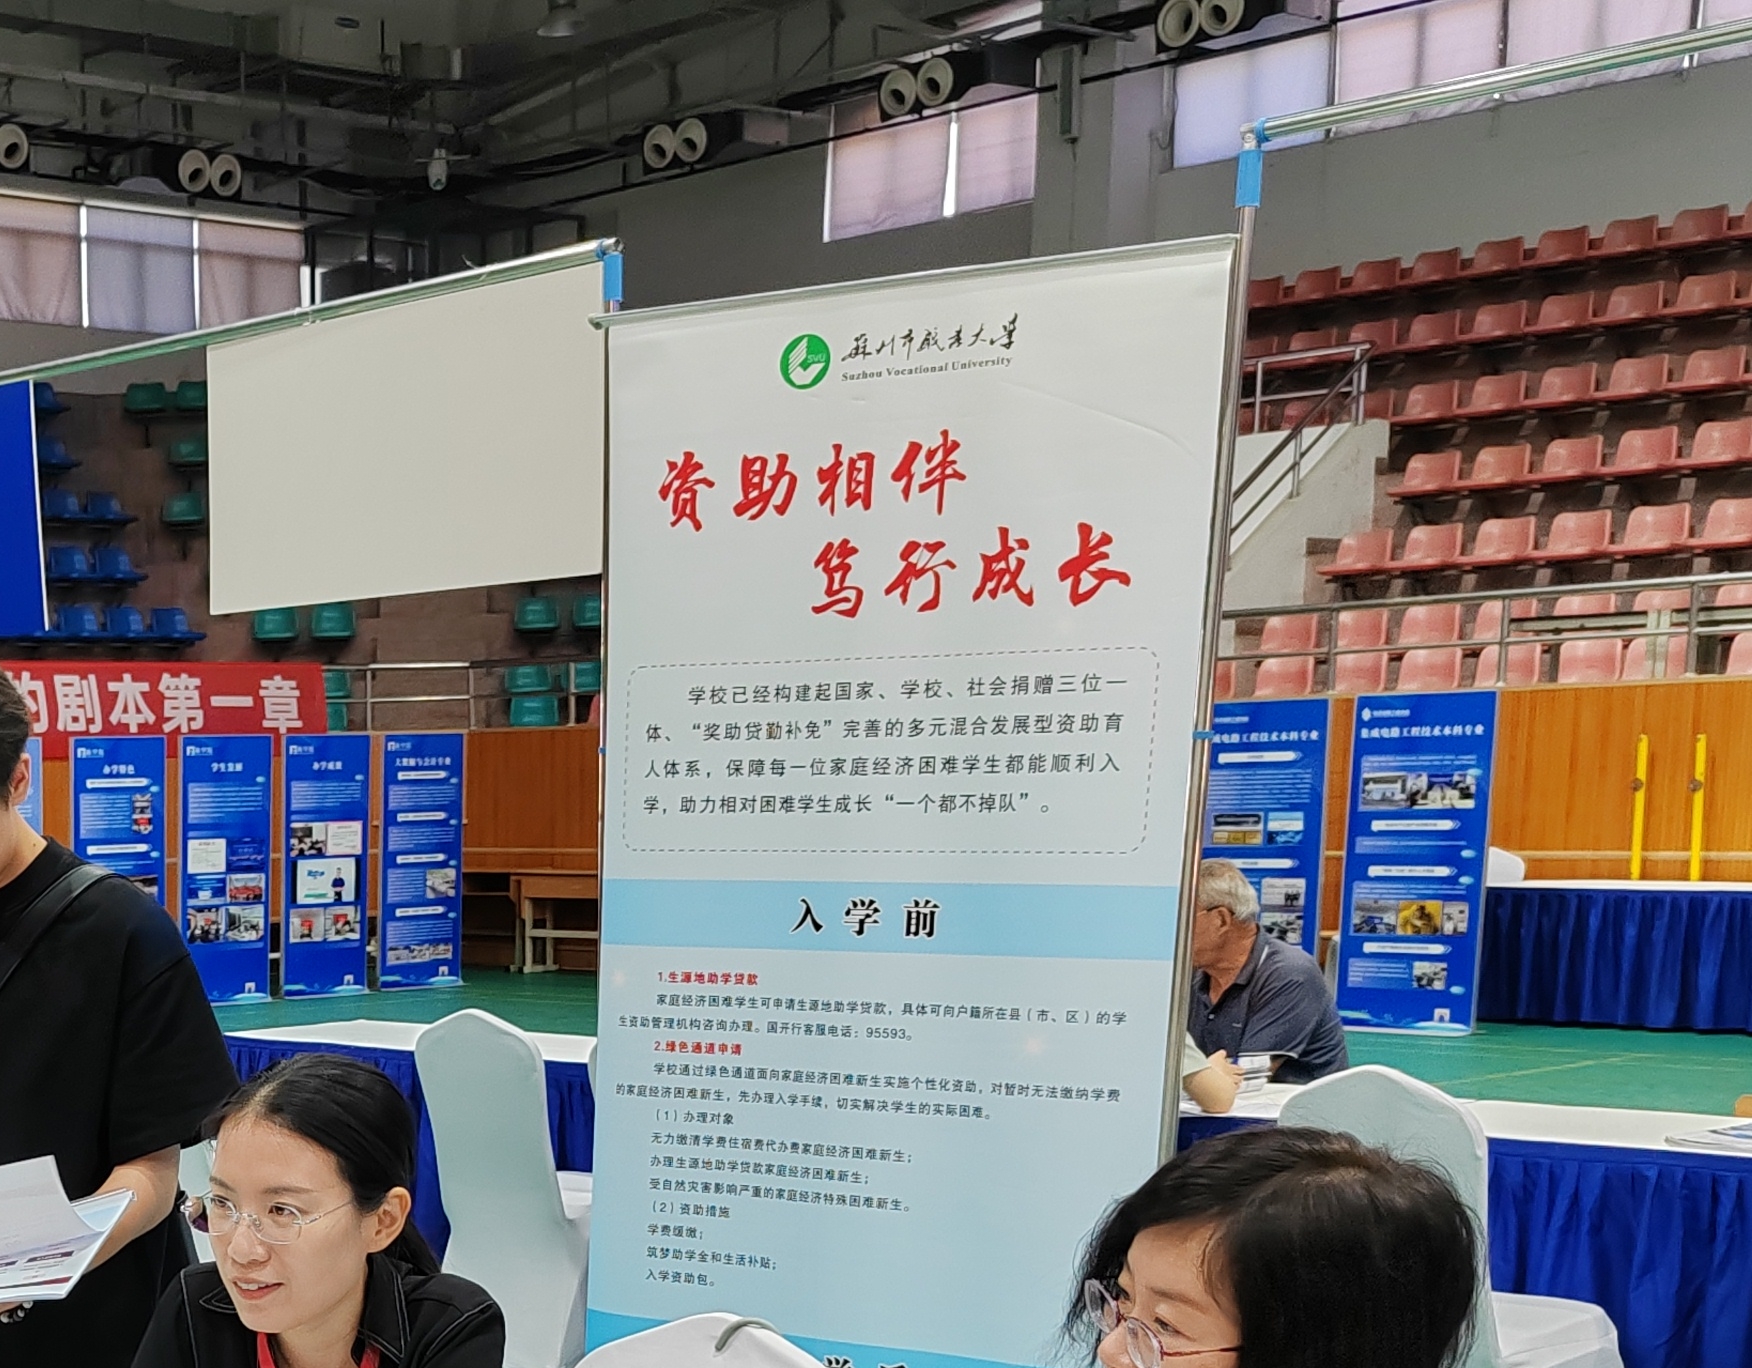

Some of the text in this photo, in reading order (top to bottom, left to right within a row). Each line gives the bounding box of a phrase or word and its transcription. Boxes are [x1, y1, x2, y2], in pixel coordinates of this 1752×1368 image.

[841, 355, 1014, 382] Suzhou Vocational University
[658, 429, 967, 531] 资助相伴
[811, 522, 1131, 618] 笃行成长
[688, 673, 1127, 705] 学校已经构建起国家、学校、社会捐赠三位一
[645, 752, 1121, 779] 人体系，保障每一位家庭经济困难学生都能顺利入
[791, 897, 941, 938] 入学前
[657, 971, 759, 986] 1.生源地助学贷款
[654, 1041, 742, 1056] 2.绿色通道申请
